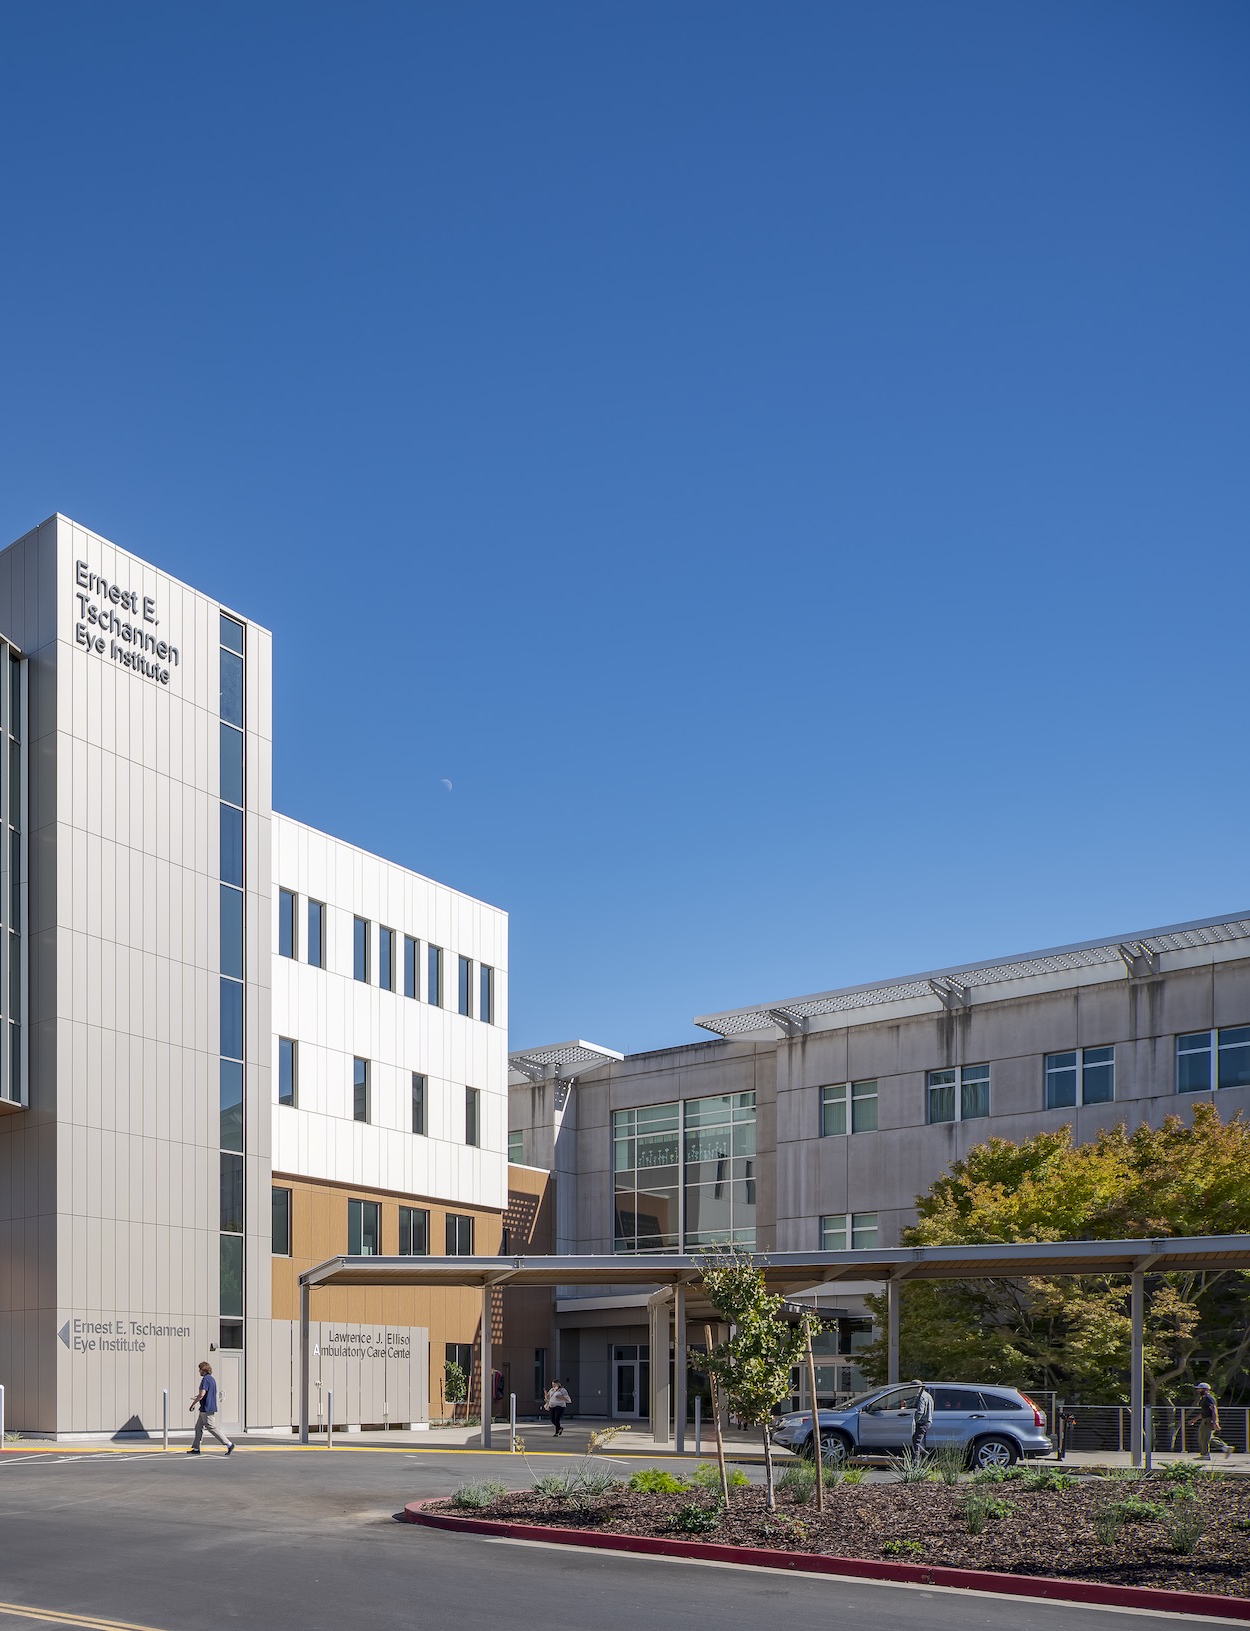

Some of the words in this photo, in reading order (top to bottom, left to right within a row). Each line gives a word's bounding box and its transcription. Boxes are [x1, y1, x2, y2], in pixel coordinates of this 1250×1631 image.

[76, 559, 139, 615] Ernest
[143, 596, 160, 626] E.
[76, 592, 180, 667] Tschannen
[76, 622, 106, 655] Eye
[110, 639, 170, 685] Institute
[73, 1318, 113, 1335] Ernest
[116, 1320, 127, 1335] E.
[129, 1321, 190, 1337] Tschannen
[329, 1330, 372, 1344] Lawrence
[376, 1332, 383, 1344] J.
[73, 1336, 96, 1354] Eye
[99, 1337, 146, 1352] Institute
[312, 1343, 367, 1361] Ambulatory
[367, 1346, 386, 1358] Care
